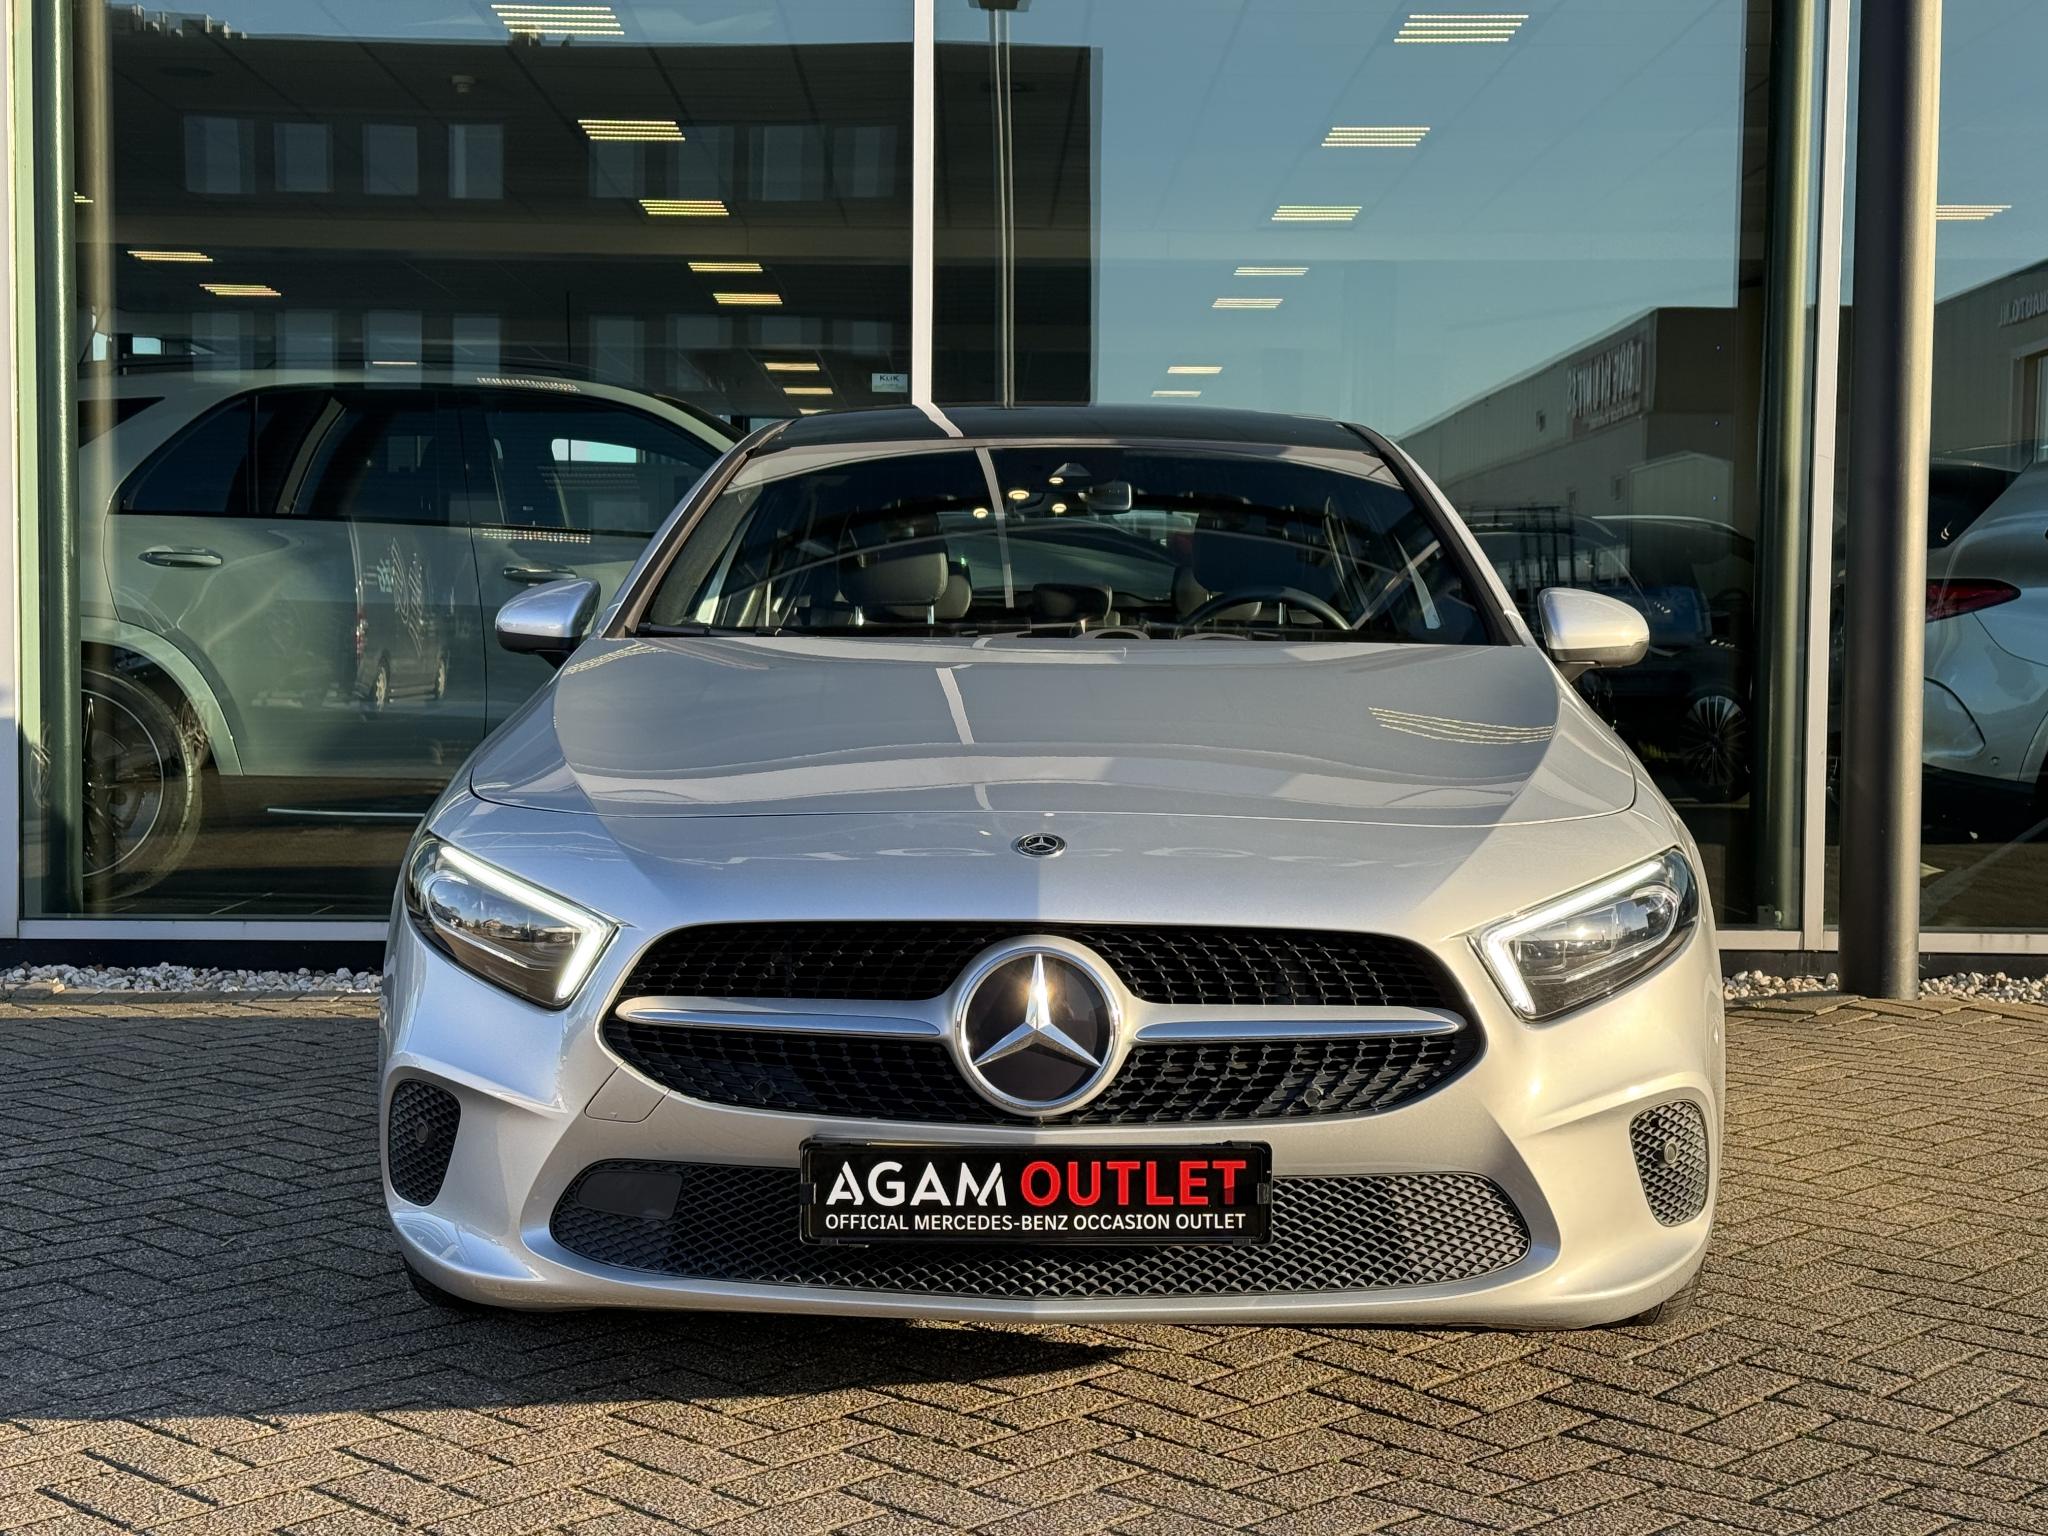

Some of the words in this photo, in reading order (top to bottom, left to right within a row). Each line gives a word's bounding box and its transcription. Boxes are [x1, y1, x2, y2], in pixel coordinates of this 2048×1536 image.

[825, 1161, 1007, 1206] AGAM
[1020, 1160, 1247, 1207] OUTLET
[825, 1213, 909, 1230] OFFICIAL
[914, 1213, 1069, 1231] MERCEDES-BENZ
[1073, 1213, 1169, 1230] OCCASION
[1175, 1212, 1246, 1230] OUTLET
